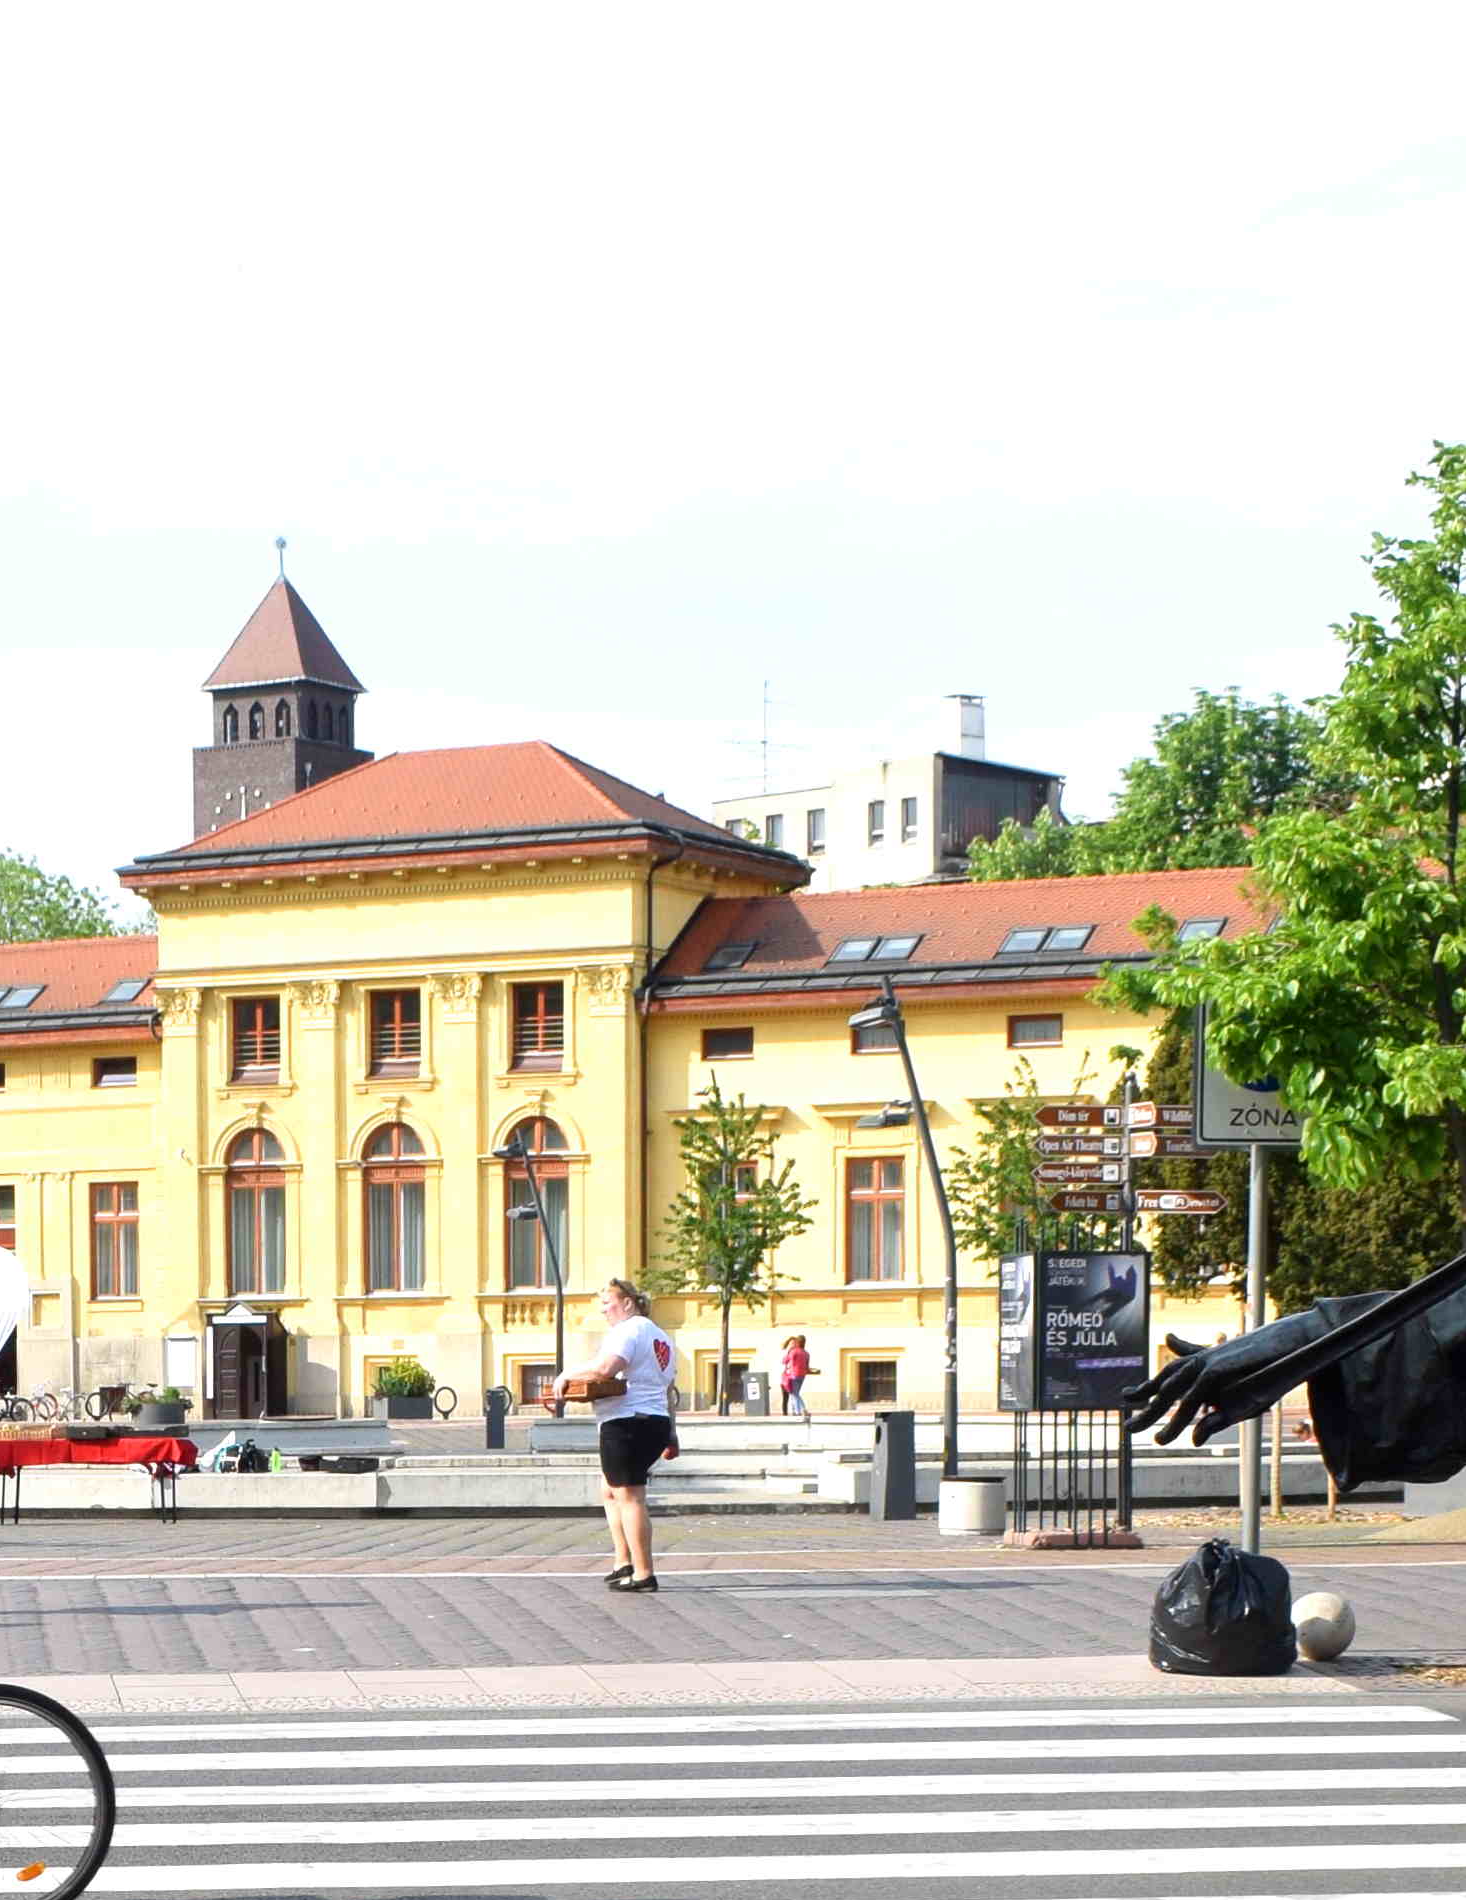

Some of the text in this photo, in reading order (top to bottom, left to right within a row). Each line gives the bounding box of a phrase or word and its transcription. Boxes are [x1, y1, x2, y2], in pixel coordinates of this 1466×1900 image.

[1229, 1103, 1298, 1127] ZÓNA
[1045, 1309, 1103, 1327] RÓMEÓ
[1045, 1328, 1117, 1346] ÉS JÚLIA
